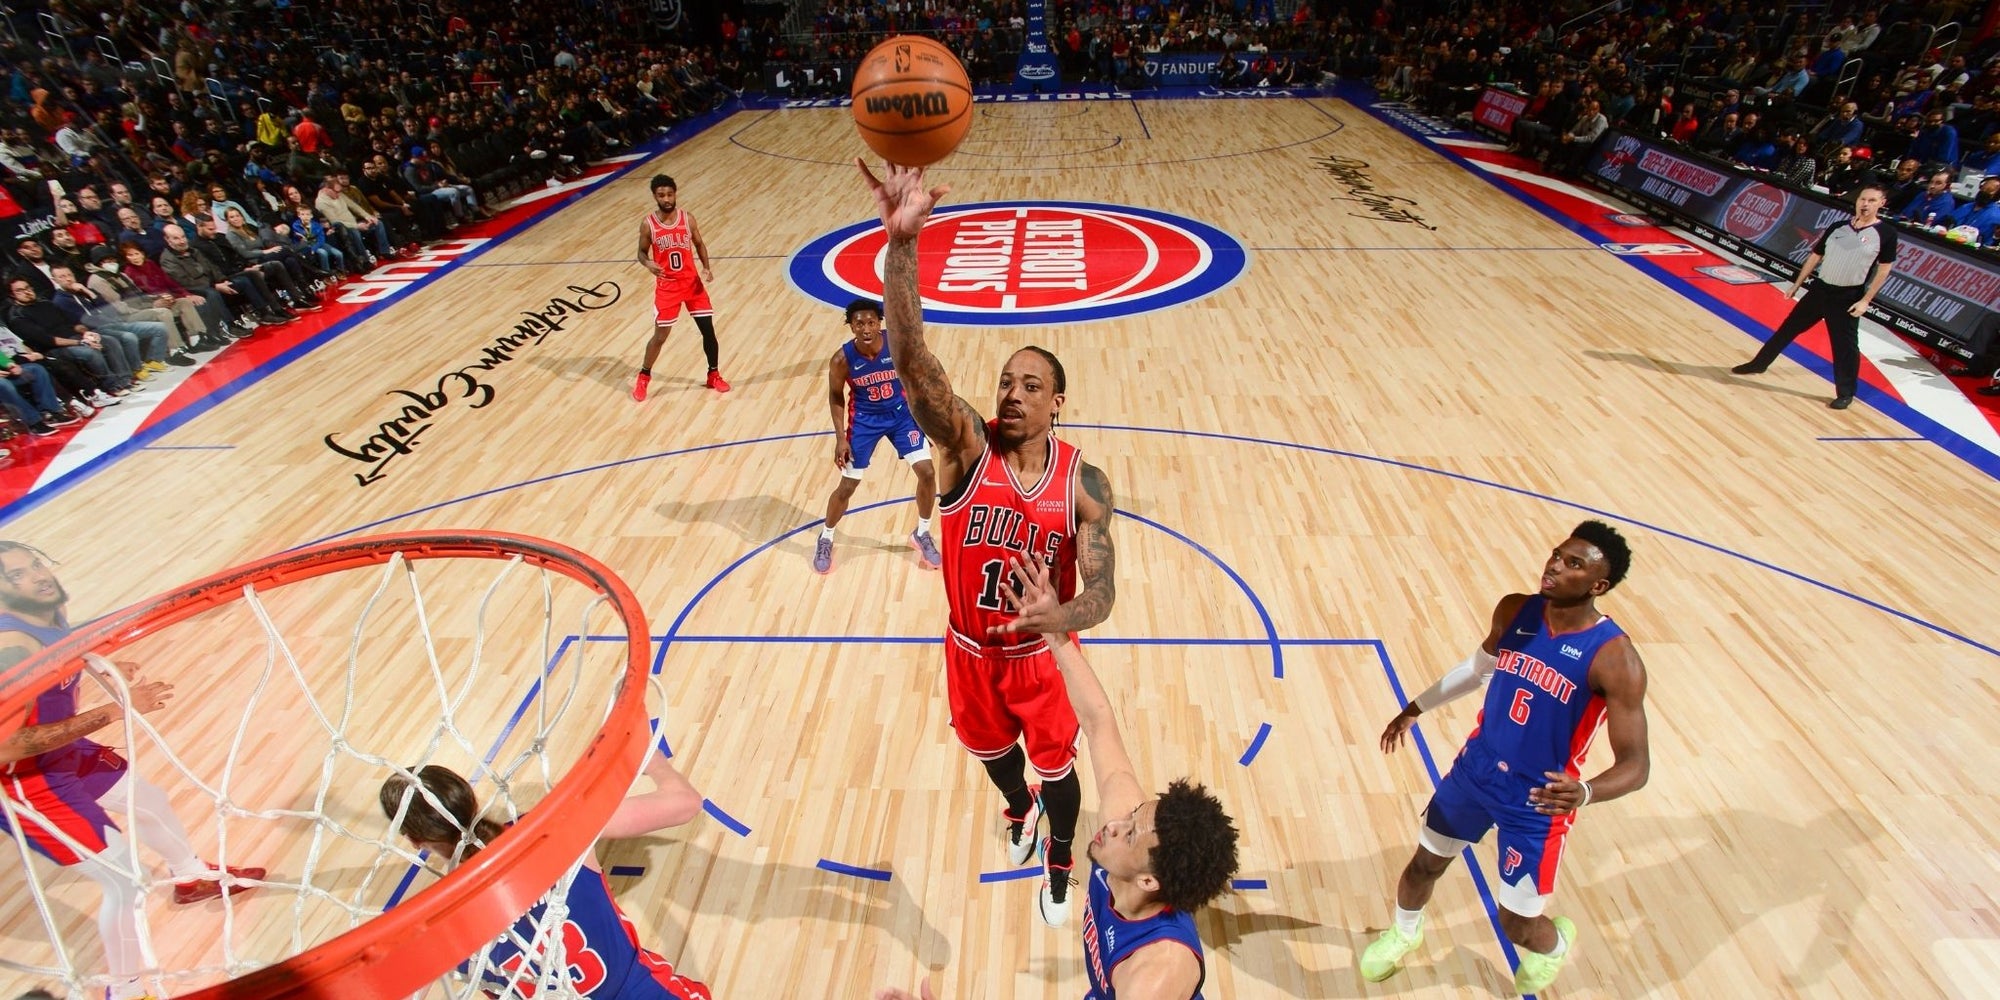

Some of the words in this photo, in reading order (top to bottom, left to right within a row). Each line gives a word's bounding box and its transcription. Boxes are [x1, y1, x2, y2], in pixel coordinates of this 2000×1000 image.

[1162, 62, 1223, 74] FANDUE
[864, 91, 950, 119] Wilson
[1741, 192, 1780, 218] DETROIT
[1730, 206, 1770, 231] PISTONS
[656, 233, 692, 252] BULLS
[937, 219, 1018, 292] PISTONS
[1018, 218, 1088, 290] DETROIT
[669, 251, 683, 271] 0
[1879, 275, 1934, 311] AILABLE
[1924, 295, 1965, 322] NOW
[853, 369, 900, 387] DETROI
[867, 382, 894, 402] 38
[962, 504, 1064, 570] BULLS
[976, 558, 1030, 613] 11
[1561, 644, 1583, 658] UWM
[1495, 648, 1577, 705] DETROIT
[1509, 688, 1534, 726] 6
[1106, 925, 1115, 950] UWM
